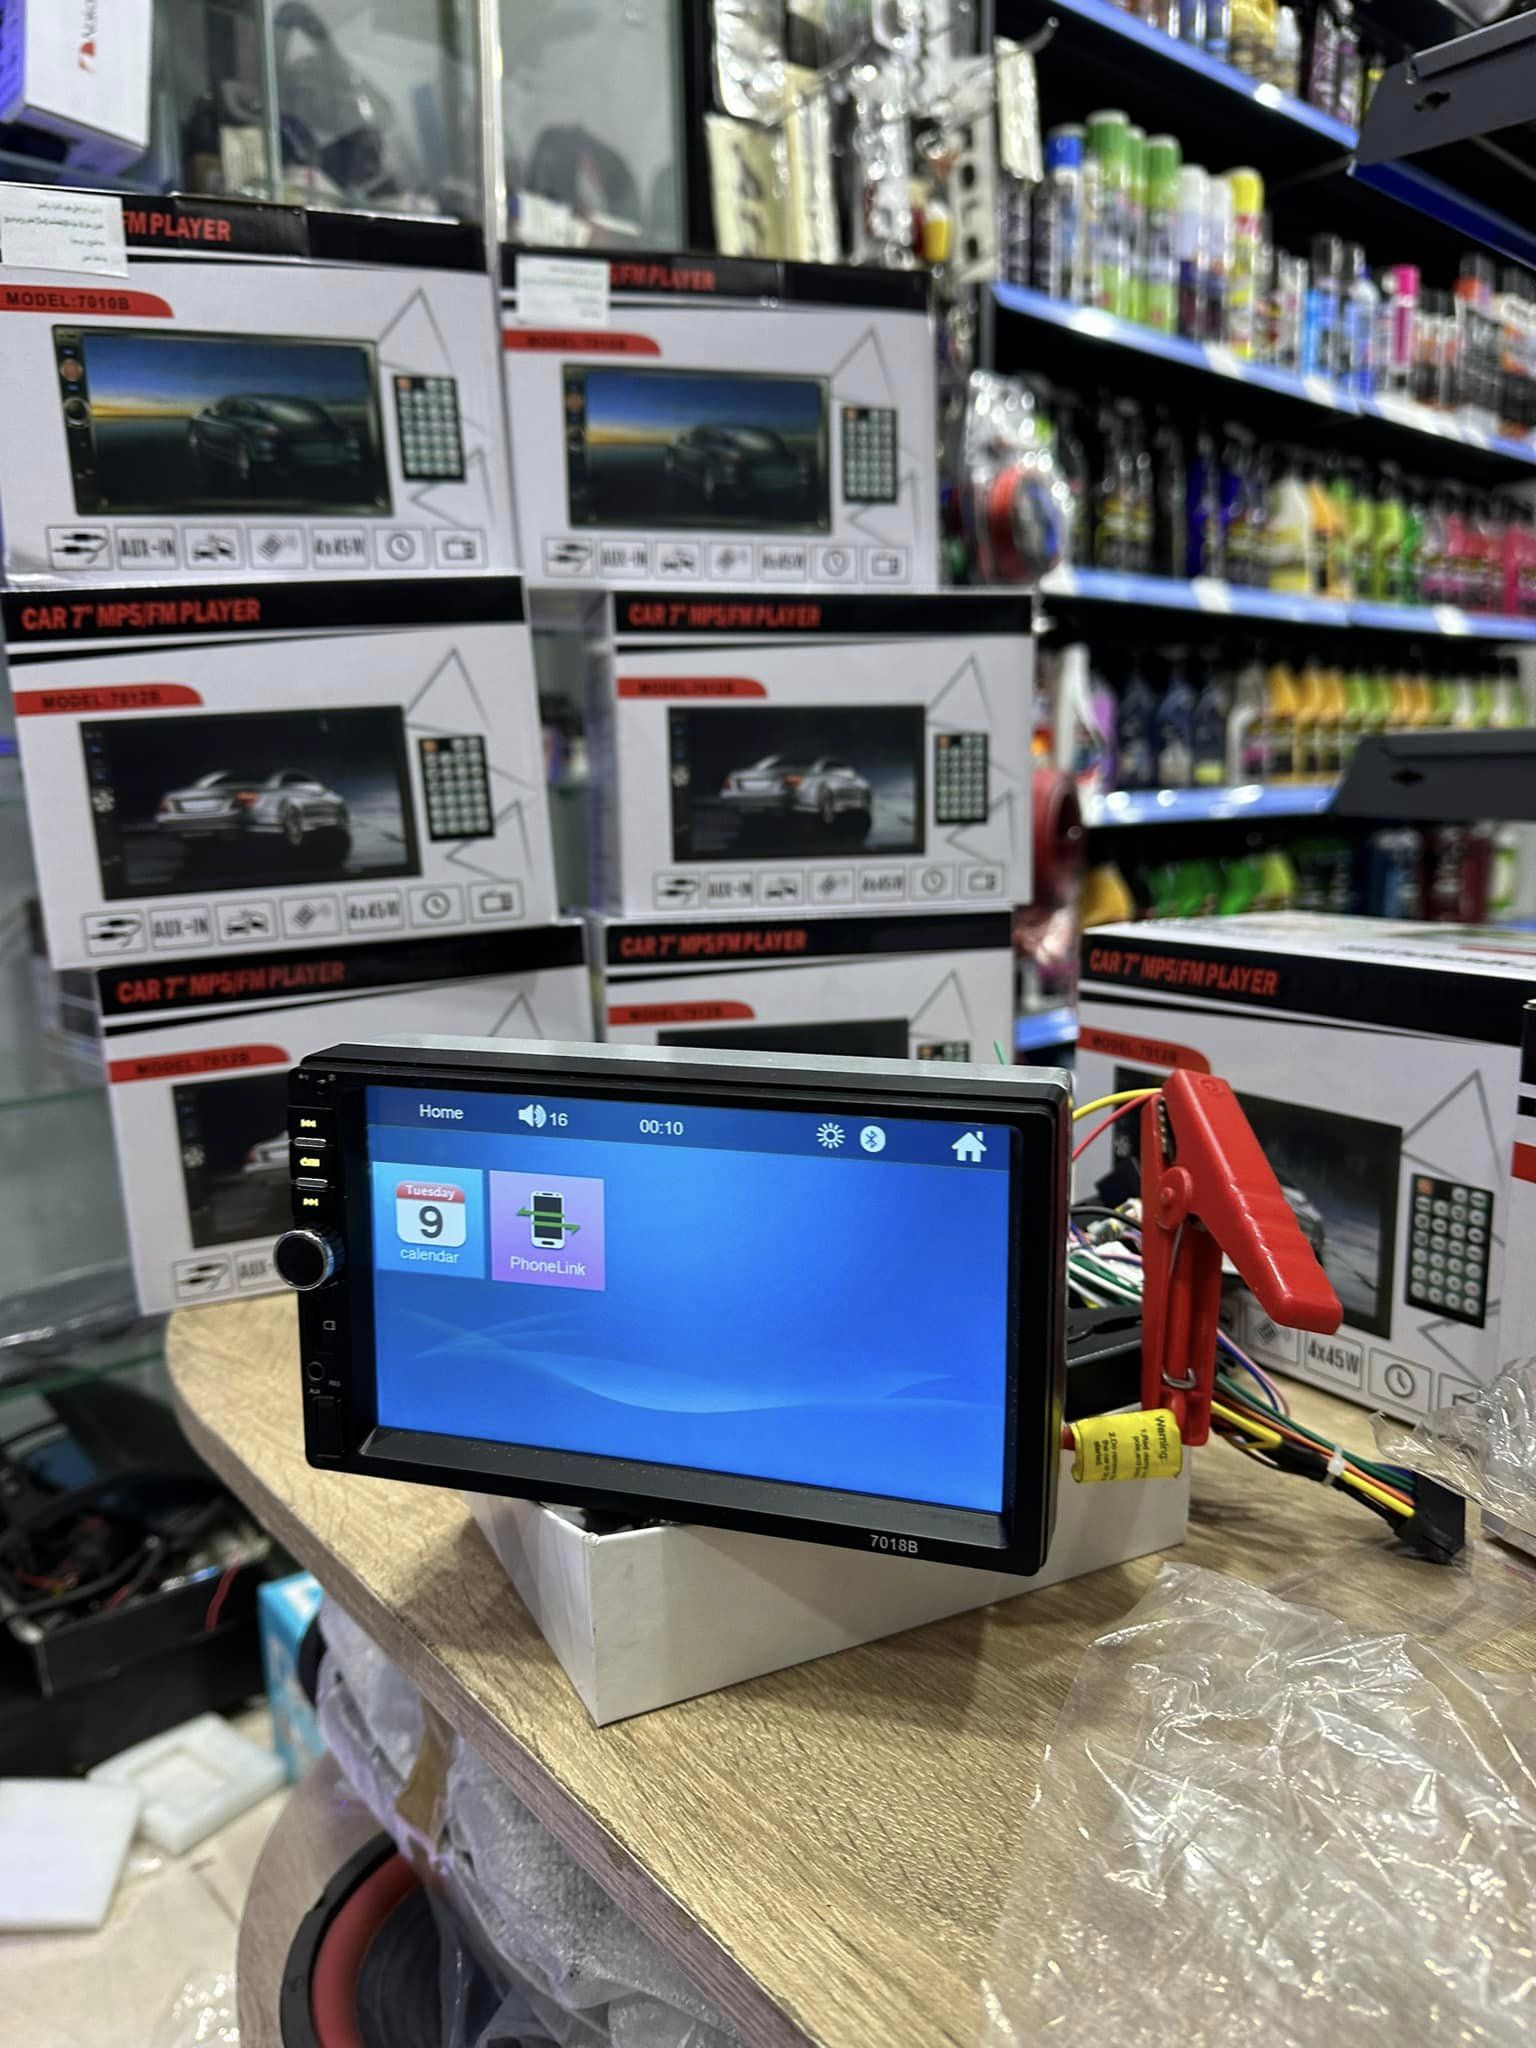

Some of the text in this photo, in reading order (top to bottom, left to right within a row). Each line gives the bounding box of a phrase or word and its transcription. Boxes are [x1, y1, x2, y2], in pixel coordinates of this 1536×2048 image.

[151, 212, 232, 242] PLAYER
[21, 606, 67, 631] CAR
[180, 598, 261, 624] PLAYER
[628, 603, 666, 626] CAR
[757, 604, 821, 628] PLAYER
[620, 935, 656, 957] CAR
[745, 929, 808, 951] PLAYER
[117, 977, 161, 1004] CAR
[268, 960, 345, 989] PLAYER
[1089, 948, 1121, 974] CAR
[1140, 955, 1205, 987] MP5/FM
[1206, 961, 1280, 997] PLAYER
[419, 1103, 465, 1120] Home
[550, 1112, 569, 1127] 16
[639, 1119, 684, 1136] 00:10
[405, 1184, 456, 1201] Tuesday
[418, 1205, 443, 1239] 9
[400, 1248, 459, 1264] calendar
[510, 1255, 587, 1276] PhoneLink
[1307, 1340, 1360, 1375] 4x45W
[869, 1534, 919, 1553] 7018B
